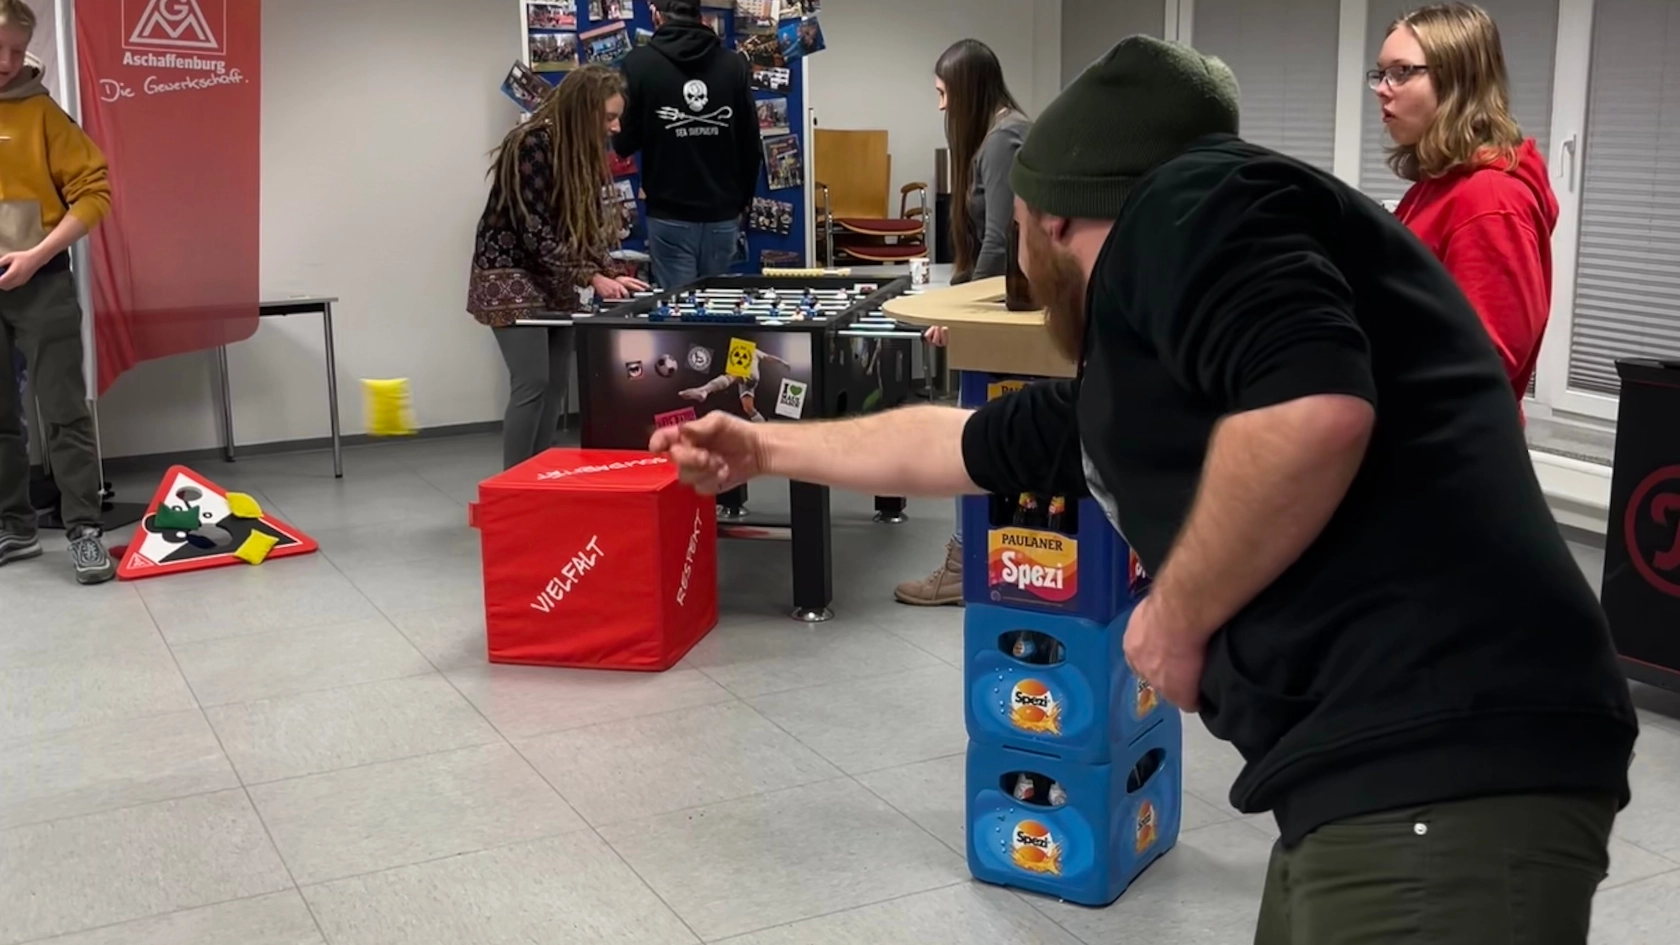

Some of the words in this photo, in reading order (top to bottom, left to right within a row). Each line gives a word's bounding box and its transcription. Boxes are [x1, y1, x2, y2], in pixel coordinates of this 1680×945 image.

[123, 52, 226, 74] Aschaffenburg
[100, 79, 135, 102] Die
[1001, 533, 1063, 551] PAULANER
[676, 508, 703, 606] RESPEKT
[530, 535, 605, 613] VIELFALT
[1001, 551, 1064, 589] Spezi
[1015, 691, 1048, 707] Spezi
[1016, 831, 1048, 848] Spezi
